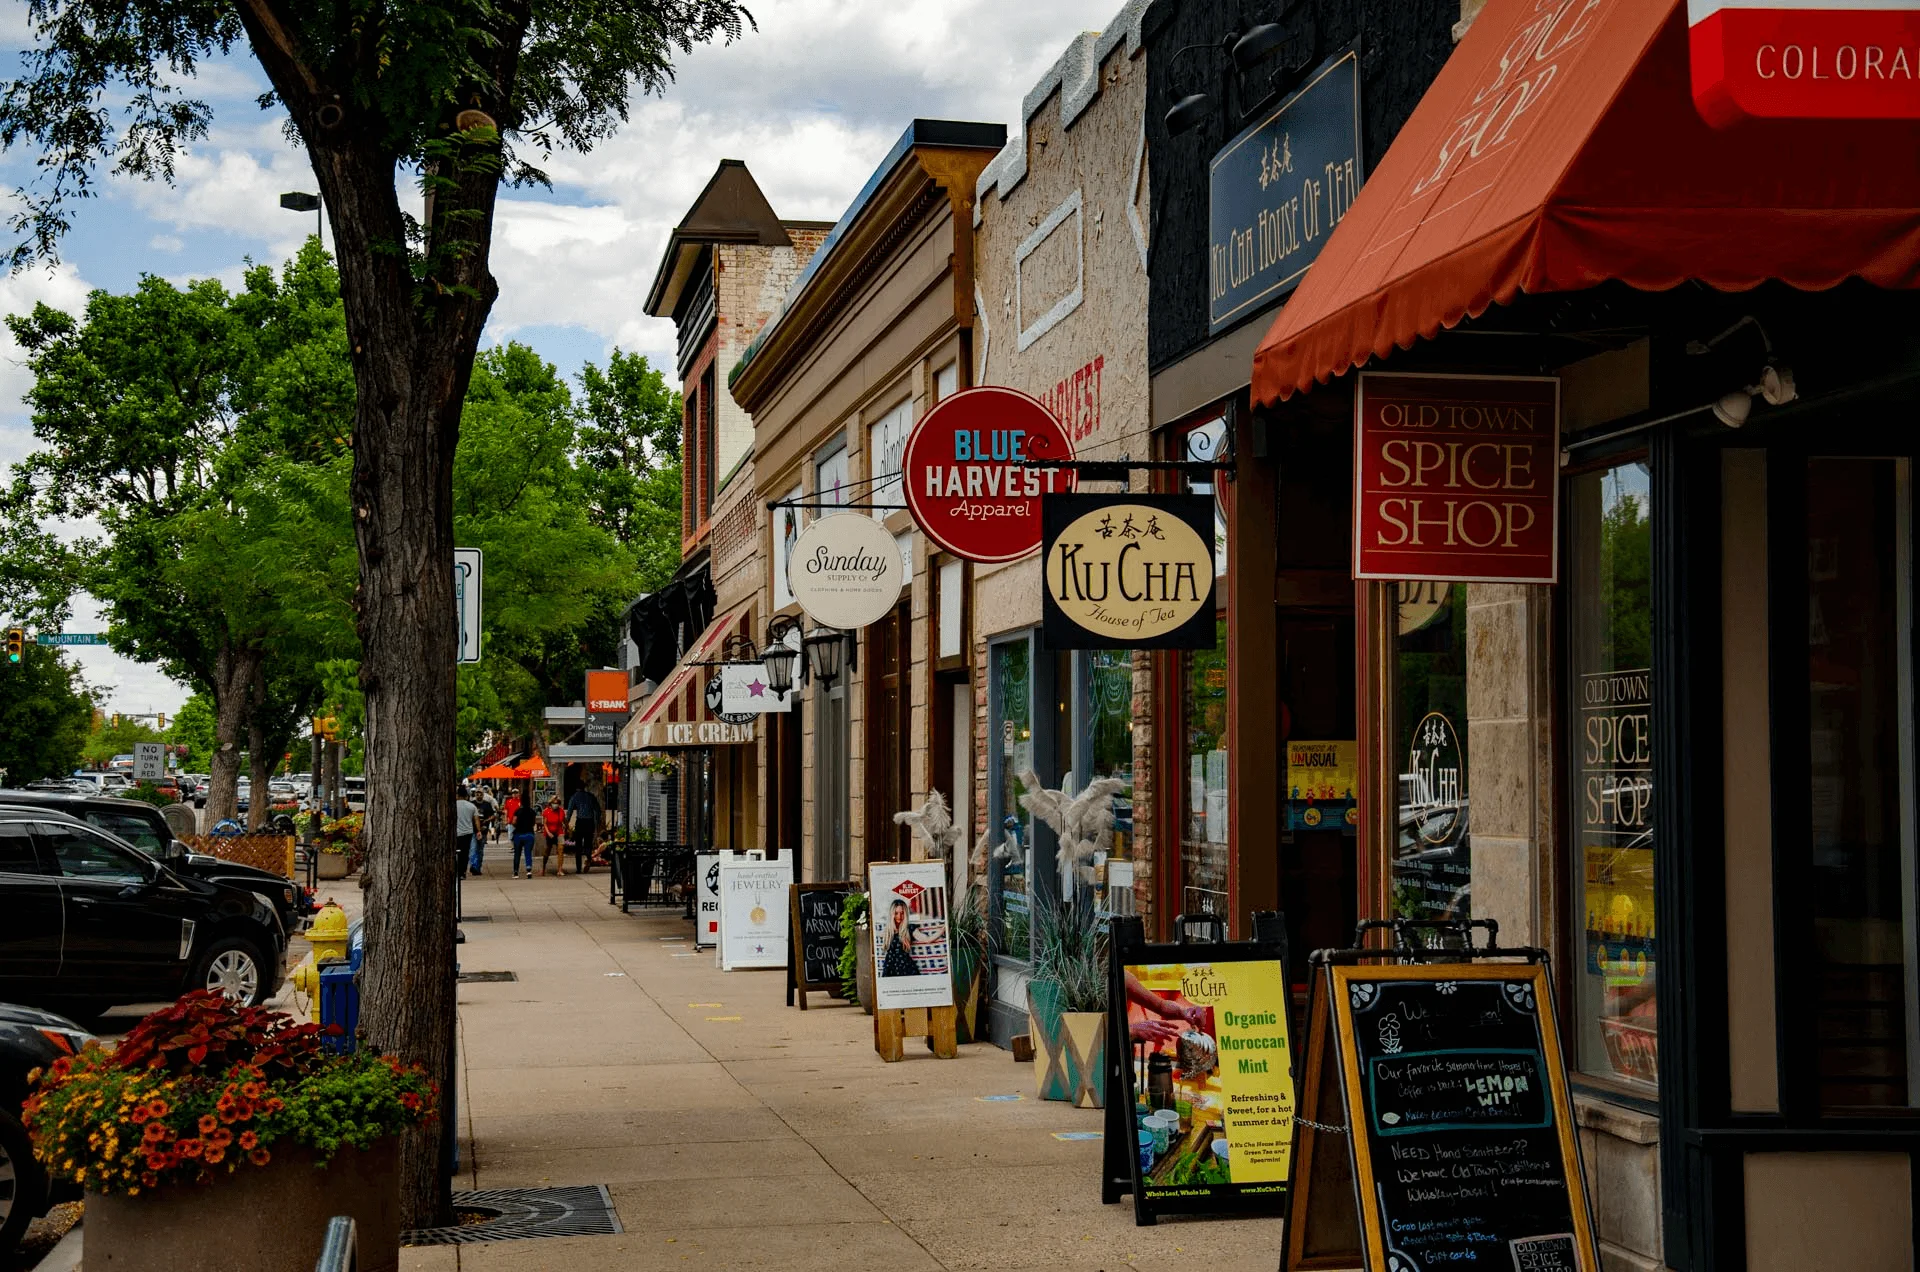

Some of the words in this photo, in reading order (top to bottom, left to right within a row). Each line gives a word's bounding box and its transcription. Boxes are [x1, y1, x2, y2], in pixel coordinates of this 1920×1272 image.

[1756, 44, 1920, 80] COLORA
[1411, 64, 1558, 197] SHOP
[1380, 403, 1440, 428] OLD
[1442, 405, 1536, 431] TOWN
[954, 429, 1027, 461] BLUE
[1379, 439, 1537, 489] SPICE
[925, 465, 1060, 497] HARVEST
[949, 500, 1031, 521] Apparel
[1377, 497, 1535, 548] SHOP
[806, 545, 887, 582] Sunday
[827, 574, 857, 582] SUPPLY
[1086, 603, 1130, 627] House
[1132, 610, 1147, 632] of
[1150, 607, 1176, 625] Tea
[47, 634, 92, 644] MOUNTAIN
[1586, 679, 1609, 704] OLD
[1609, 675, 1649, 702] TOWN
[666, 724, 693, 744] ICE
[697, 721, 755, 743] CREAM
[1586, 715, 1650, 764] SPICE
[1291, 752, 1338, 767] UNUSUAL
[1586, 776, 1651, 826] SHOP
[733, 879, 783, 891] JEWELRY
[813, 900, 838, 917] NEW
[1224, 1010, 1276, 1029] Organic
[1220, 1035, 1285, 1051] Moroccan
[1238, 1058, 1269, 1073] Mint
[1378, 1062, 1402, 1081] Our
[1464, 1074, 1529, 1095] LEMON
[1231, 1094, 1280, 1103] Refreshing
[1280, 1092, 1287, 1100] &
[1477, 1091, 1513, 1107] WIT
[1227, 1106, 1256, 1115] Sweet,
[1257, 1105, 1269, 1113] for
[1278, 1104, 1293, 1113] hot
[1232, 1119, 1270, 1127] summer
[1271, 1117, 1289, 1126] day!
[1250, 1156, 1281, 1164] Spearmint
[1391, 1141, 1430, 1161] NEED
[1432, 1143, 1462, 1161] Hand
[1180, 1189, 1199, 1197] Whole
[1516, 1241, 1538, 1253] OLD
[1519, 1251, 1563, 1267] SPICE
